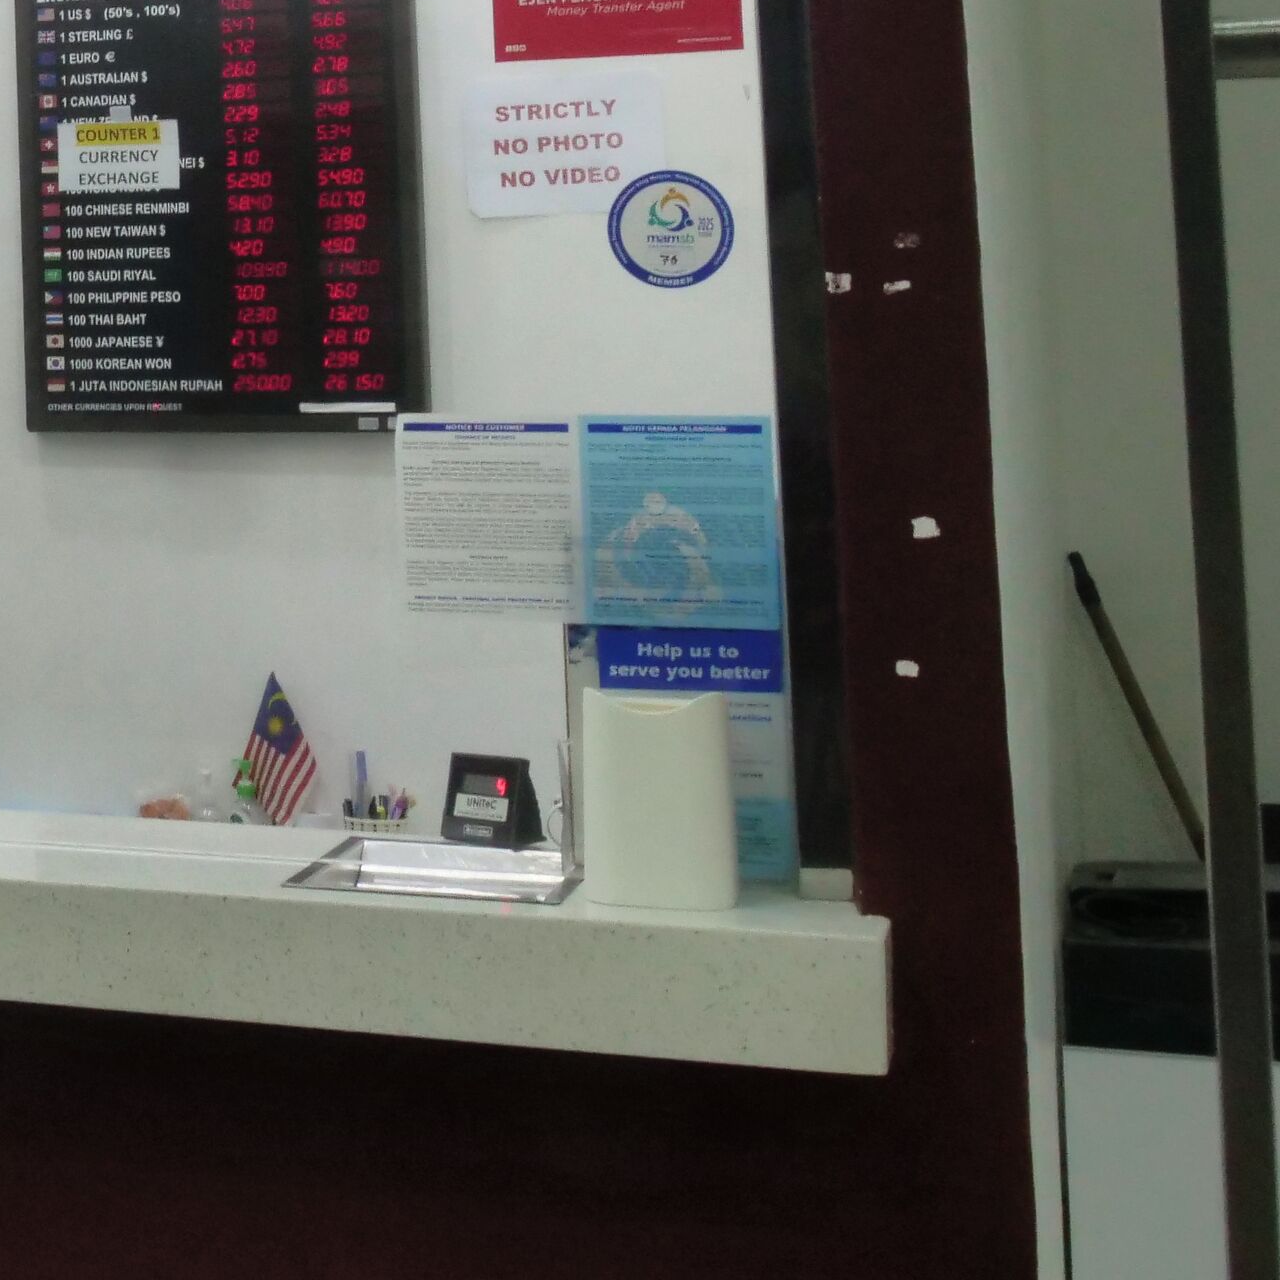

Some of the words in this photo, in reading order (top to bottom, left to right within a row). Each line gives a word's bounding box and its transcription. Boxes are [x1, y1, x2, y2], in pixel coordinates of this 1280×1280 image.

[68, 10, 82, 20] US
[104, 6, 133, 20] (50's
[144, 4, 180, 16] 100's)
[547, 5, 587, 17] Money
[593, 1, 642, 14] Transfer
[647, 0, 684, 11] Agent
[68, 29, 121, 43] STERLING
[70, 52, 99, 64] EURO
[70, 72, 138, 85] AUSTRALIAN
[71, 95, 126, 107] CANADIAN
[495, 99, 616, 122] STRICTLY
[77, 129, 147, 142] COUNTER
[153, 129, 160, 139] 1
[494, 139, 528, 155] NO
[537, 132, 623, 153] PHOTO
[80, 150, 158, 163] CURRENCY
[79, 172, 159, 185] EXCHANGE
[501, 171, 535, 187] NO
[544, 166, 621, 186] VIDEO
[66, 206, 82, 216] 100
[86, 204, 132, 215] CHINESE
[136, 203, 189, 214] RENMINBI
[66, 228, 82, 239] 100
[86, 227, 111, 238] NEW
[114, 226, 156, 237] TAIWAN
[67, 250, 83, 260] 100
[87, 249, 123, 260] INDIAN
[126, 248, 170, 259] RUPEES
[68, 272, 85, 282] 100
[88, 271, 121, 281] SAUDI
[124, 270, 156, 281] RIYAL
[68, 293, 85, 303] 100
[88, 292, 148, 303] PHILIPPINE
[151, 291, 181, 302] PESO
[69, 315, 85, 325] 100
[89, 315, 114, 325] THAI
[117, 314, 146, 325] BAHT
[69, 337, 92, 348] 1000
[95, 336, 152, 348] JAPANESE
[70, 359, 92, 369] 1000
[96, 358, 142, 369] KOREAN
[145, 358, 172, 369] WON
[79, 382, 107, 392] JUTA
[110, 380, 173, 391] INDONESIAN
[180, 380, 222, 391] RUPIAH
[48, 403, 72, 411] OTHER
[637, 643, 682, 661] Help
[690, 647, 712, 659] us
[718, 644, 739, 659] to
[609, 664, 660, 678] serve
[667, 665, 702, 681] you
[711, 664, 770, 680] better
